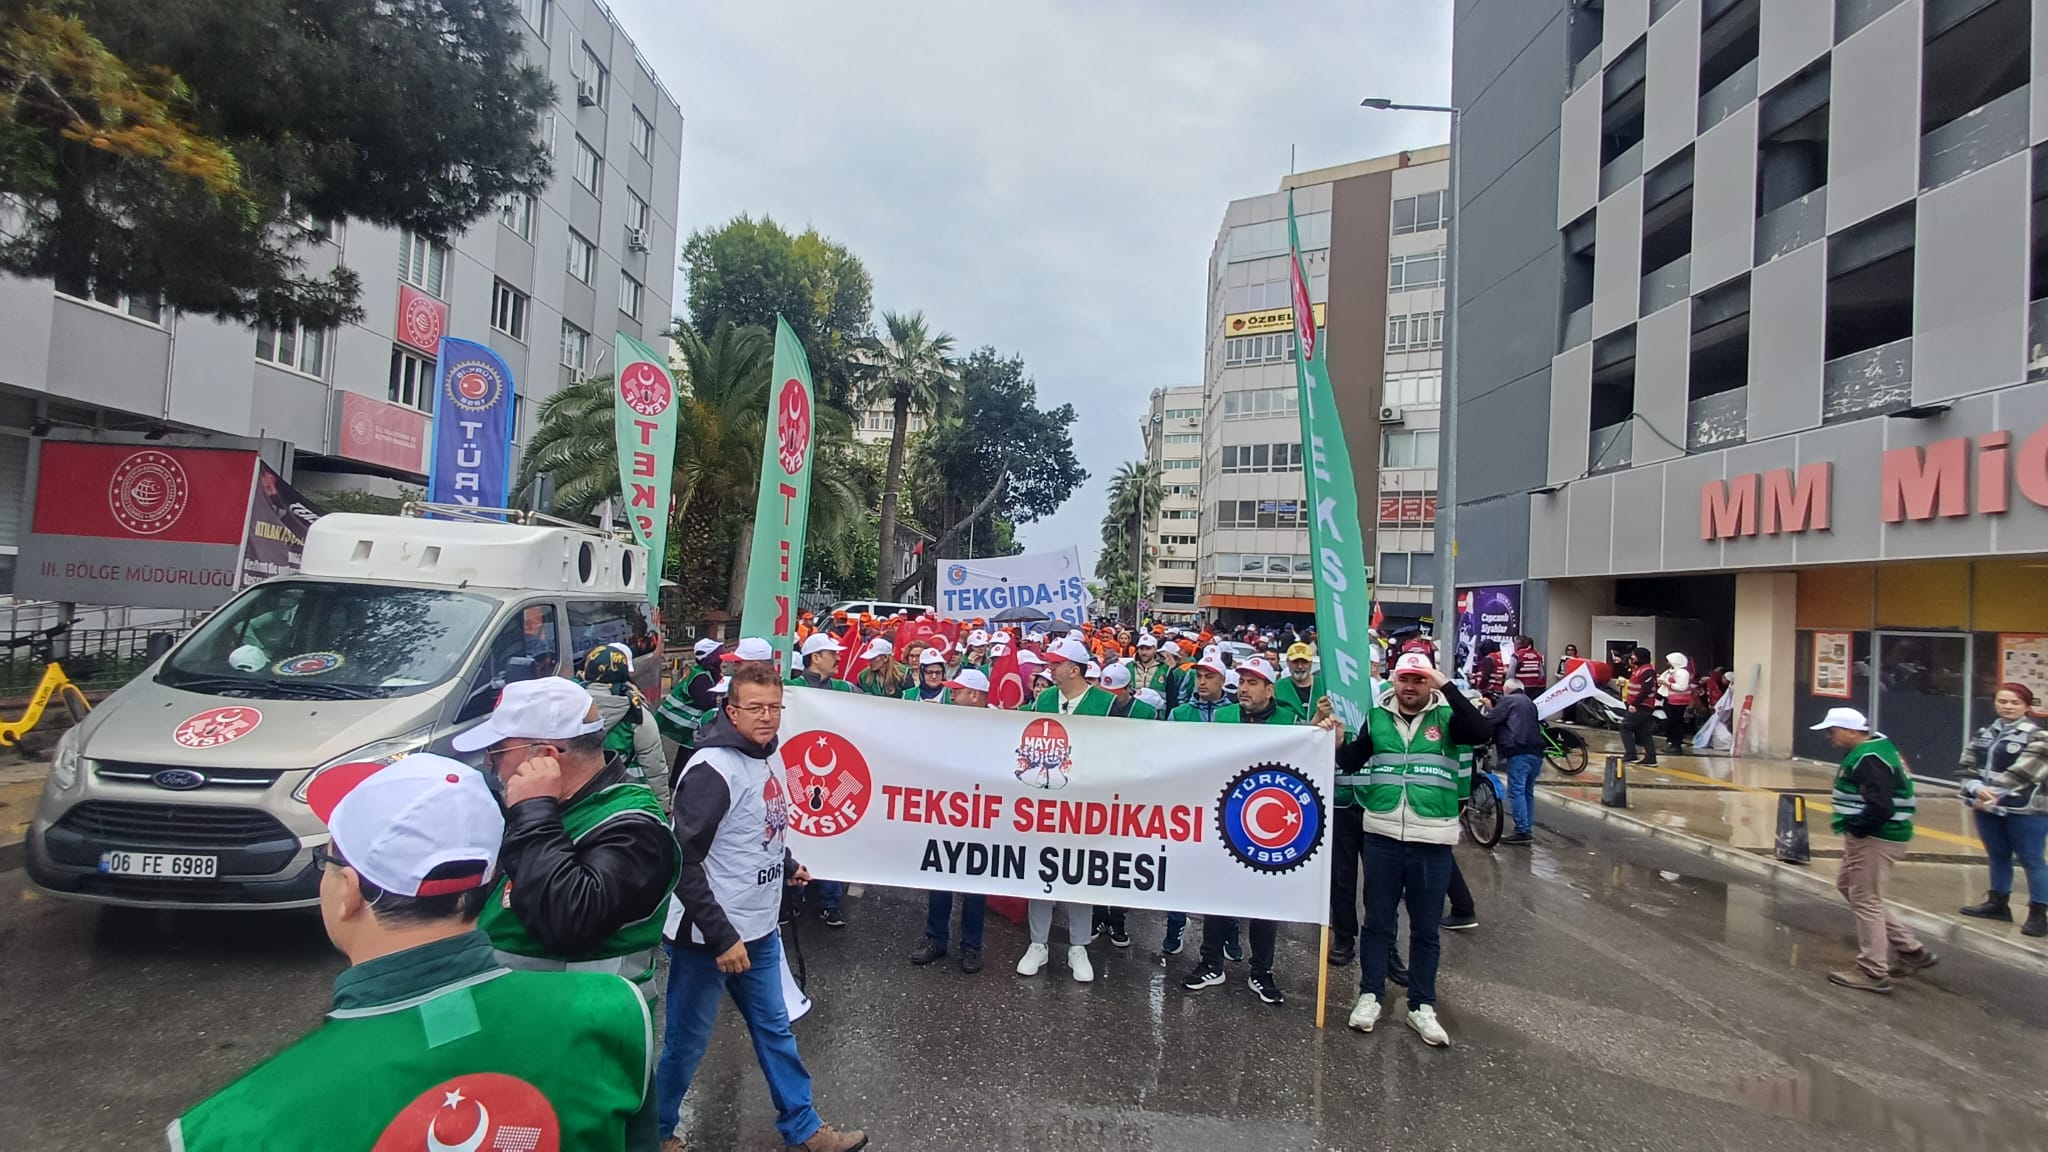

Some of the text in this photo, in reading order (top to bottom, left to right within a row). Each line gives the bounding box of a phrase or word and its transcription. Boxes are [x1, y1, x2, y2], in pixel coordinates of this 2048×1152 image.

[1247, 313, 1295, 325] ÖZBEL
[1701, 461, 1833, 541] MM
[41, 561, 60, 577] III.
[65, 561, 120, 581] BÖLGE
[126, 564, 236, 587] MÜDÜRLÜĞÜ
[943, 575, 1083, 612] TEKGIDA-İŞ
[1043, 721, 1049, 737] 1
[1024, 736, 1065, 753] MAYIS
[161, 772, 190, 786] Ford
[1231, 774, 1311, 806] TÜRK-İŞ
[788, 798, 859, 834] EKSİF
[882, 784, 1204, 843] TEKSİF SENDİKASI
[111, 852, 215, 875] 06 FE 6988
[920, 838, 1168, 894] AYDIN ŞUBESİ
[1246, 846, 1298, 863] 1952
